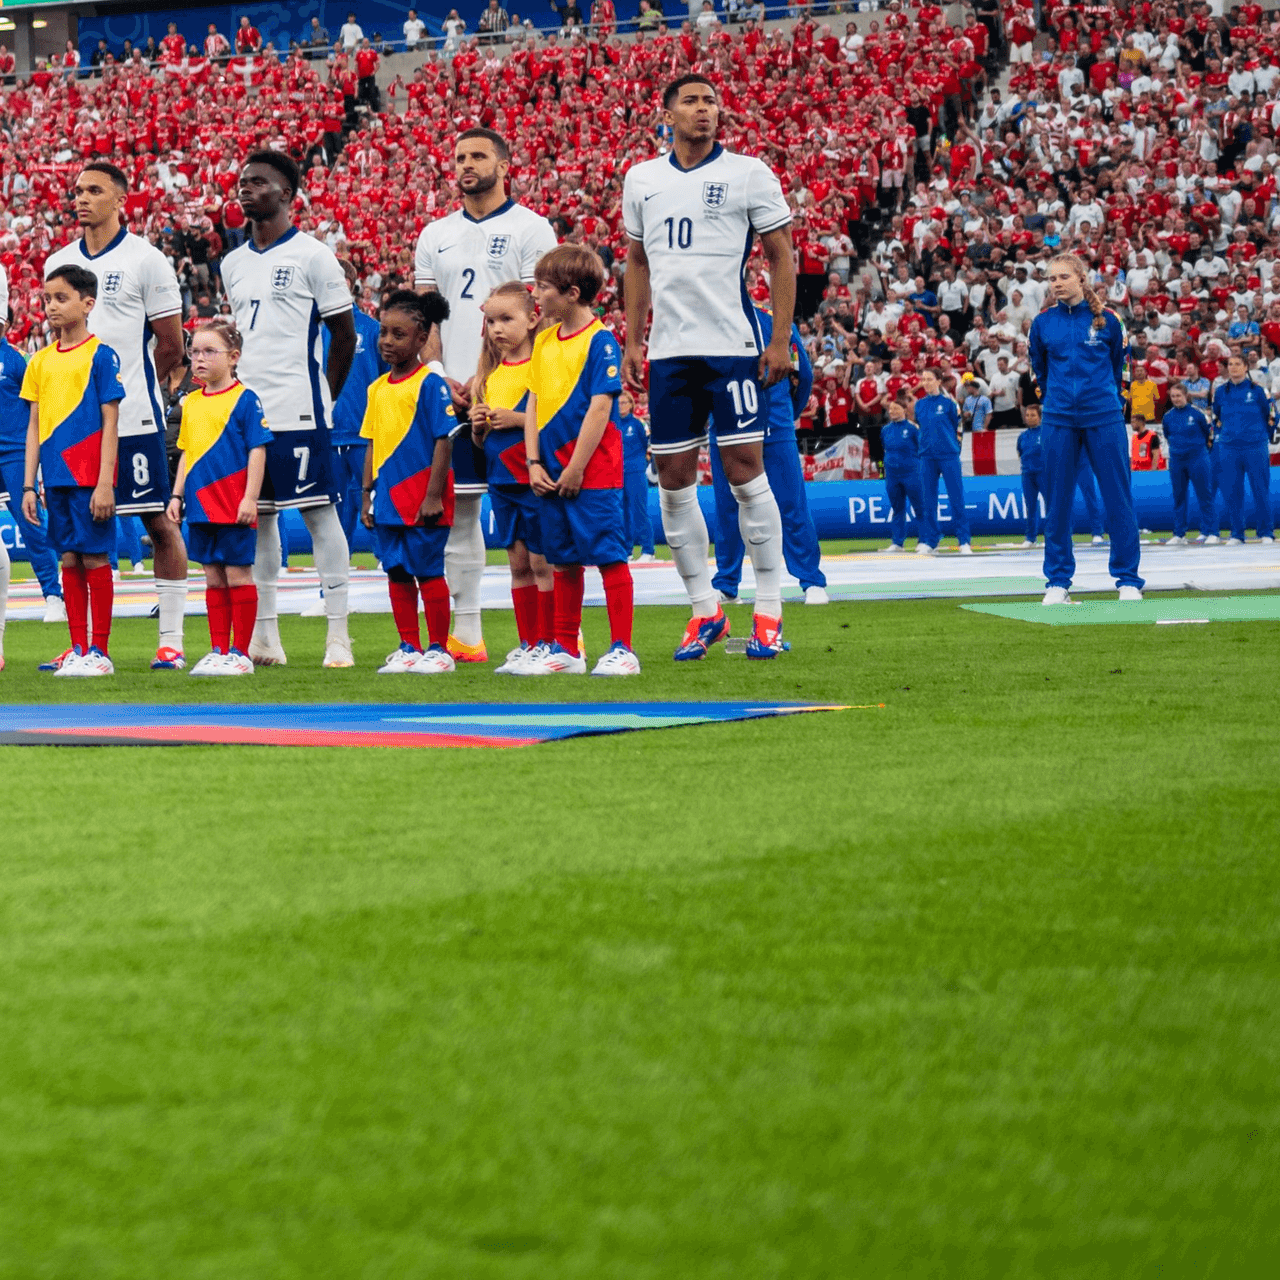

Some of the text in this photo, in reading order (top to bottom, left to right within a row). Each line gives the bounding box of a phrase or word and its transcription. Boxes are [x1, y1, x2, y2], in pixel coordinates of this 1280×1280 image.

[664, 216, 693, 250] 10
[460, 267, 476, 299] 2
[250, 299, 261, 332] 7
[726, 378, 759, 415] 10
[131, 452, 150, 486] 8
[293, 446, 310, 481] 7
